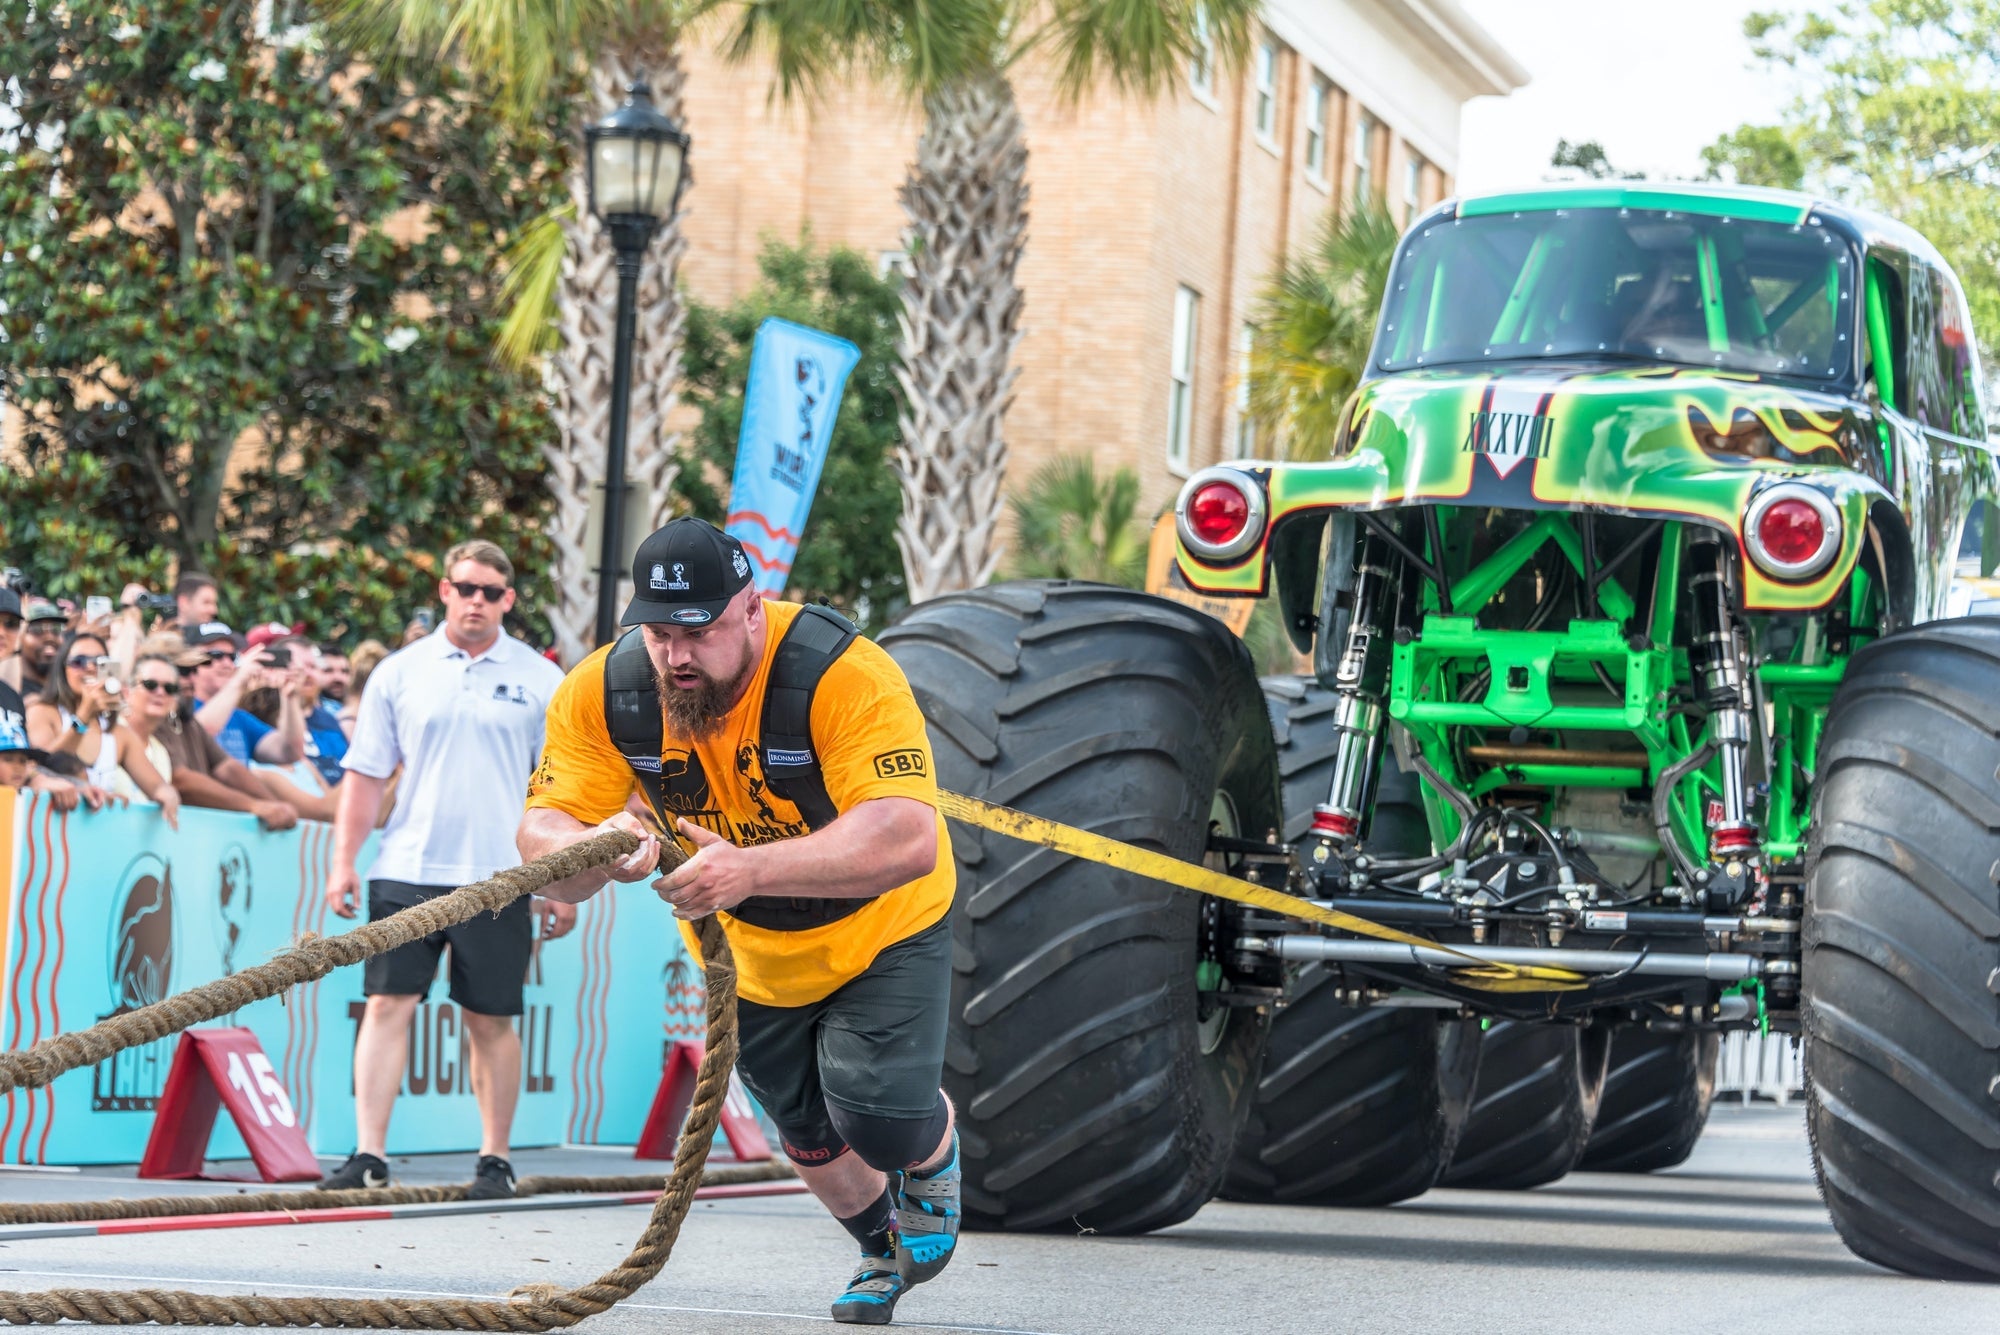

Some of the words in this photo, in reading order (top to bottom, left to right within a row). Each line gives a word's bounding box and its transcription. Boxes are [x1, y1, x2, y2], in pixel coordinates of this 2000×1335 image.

[629, 760, 660, 769] ONMIND
[881, 753, 923, 775] SBD
[227, 1051, 296, 1128] 15
